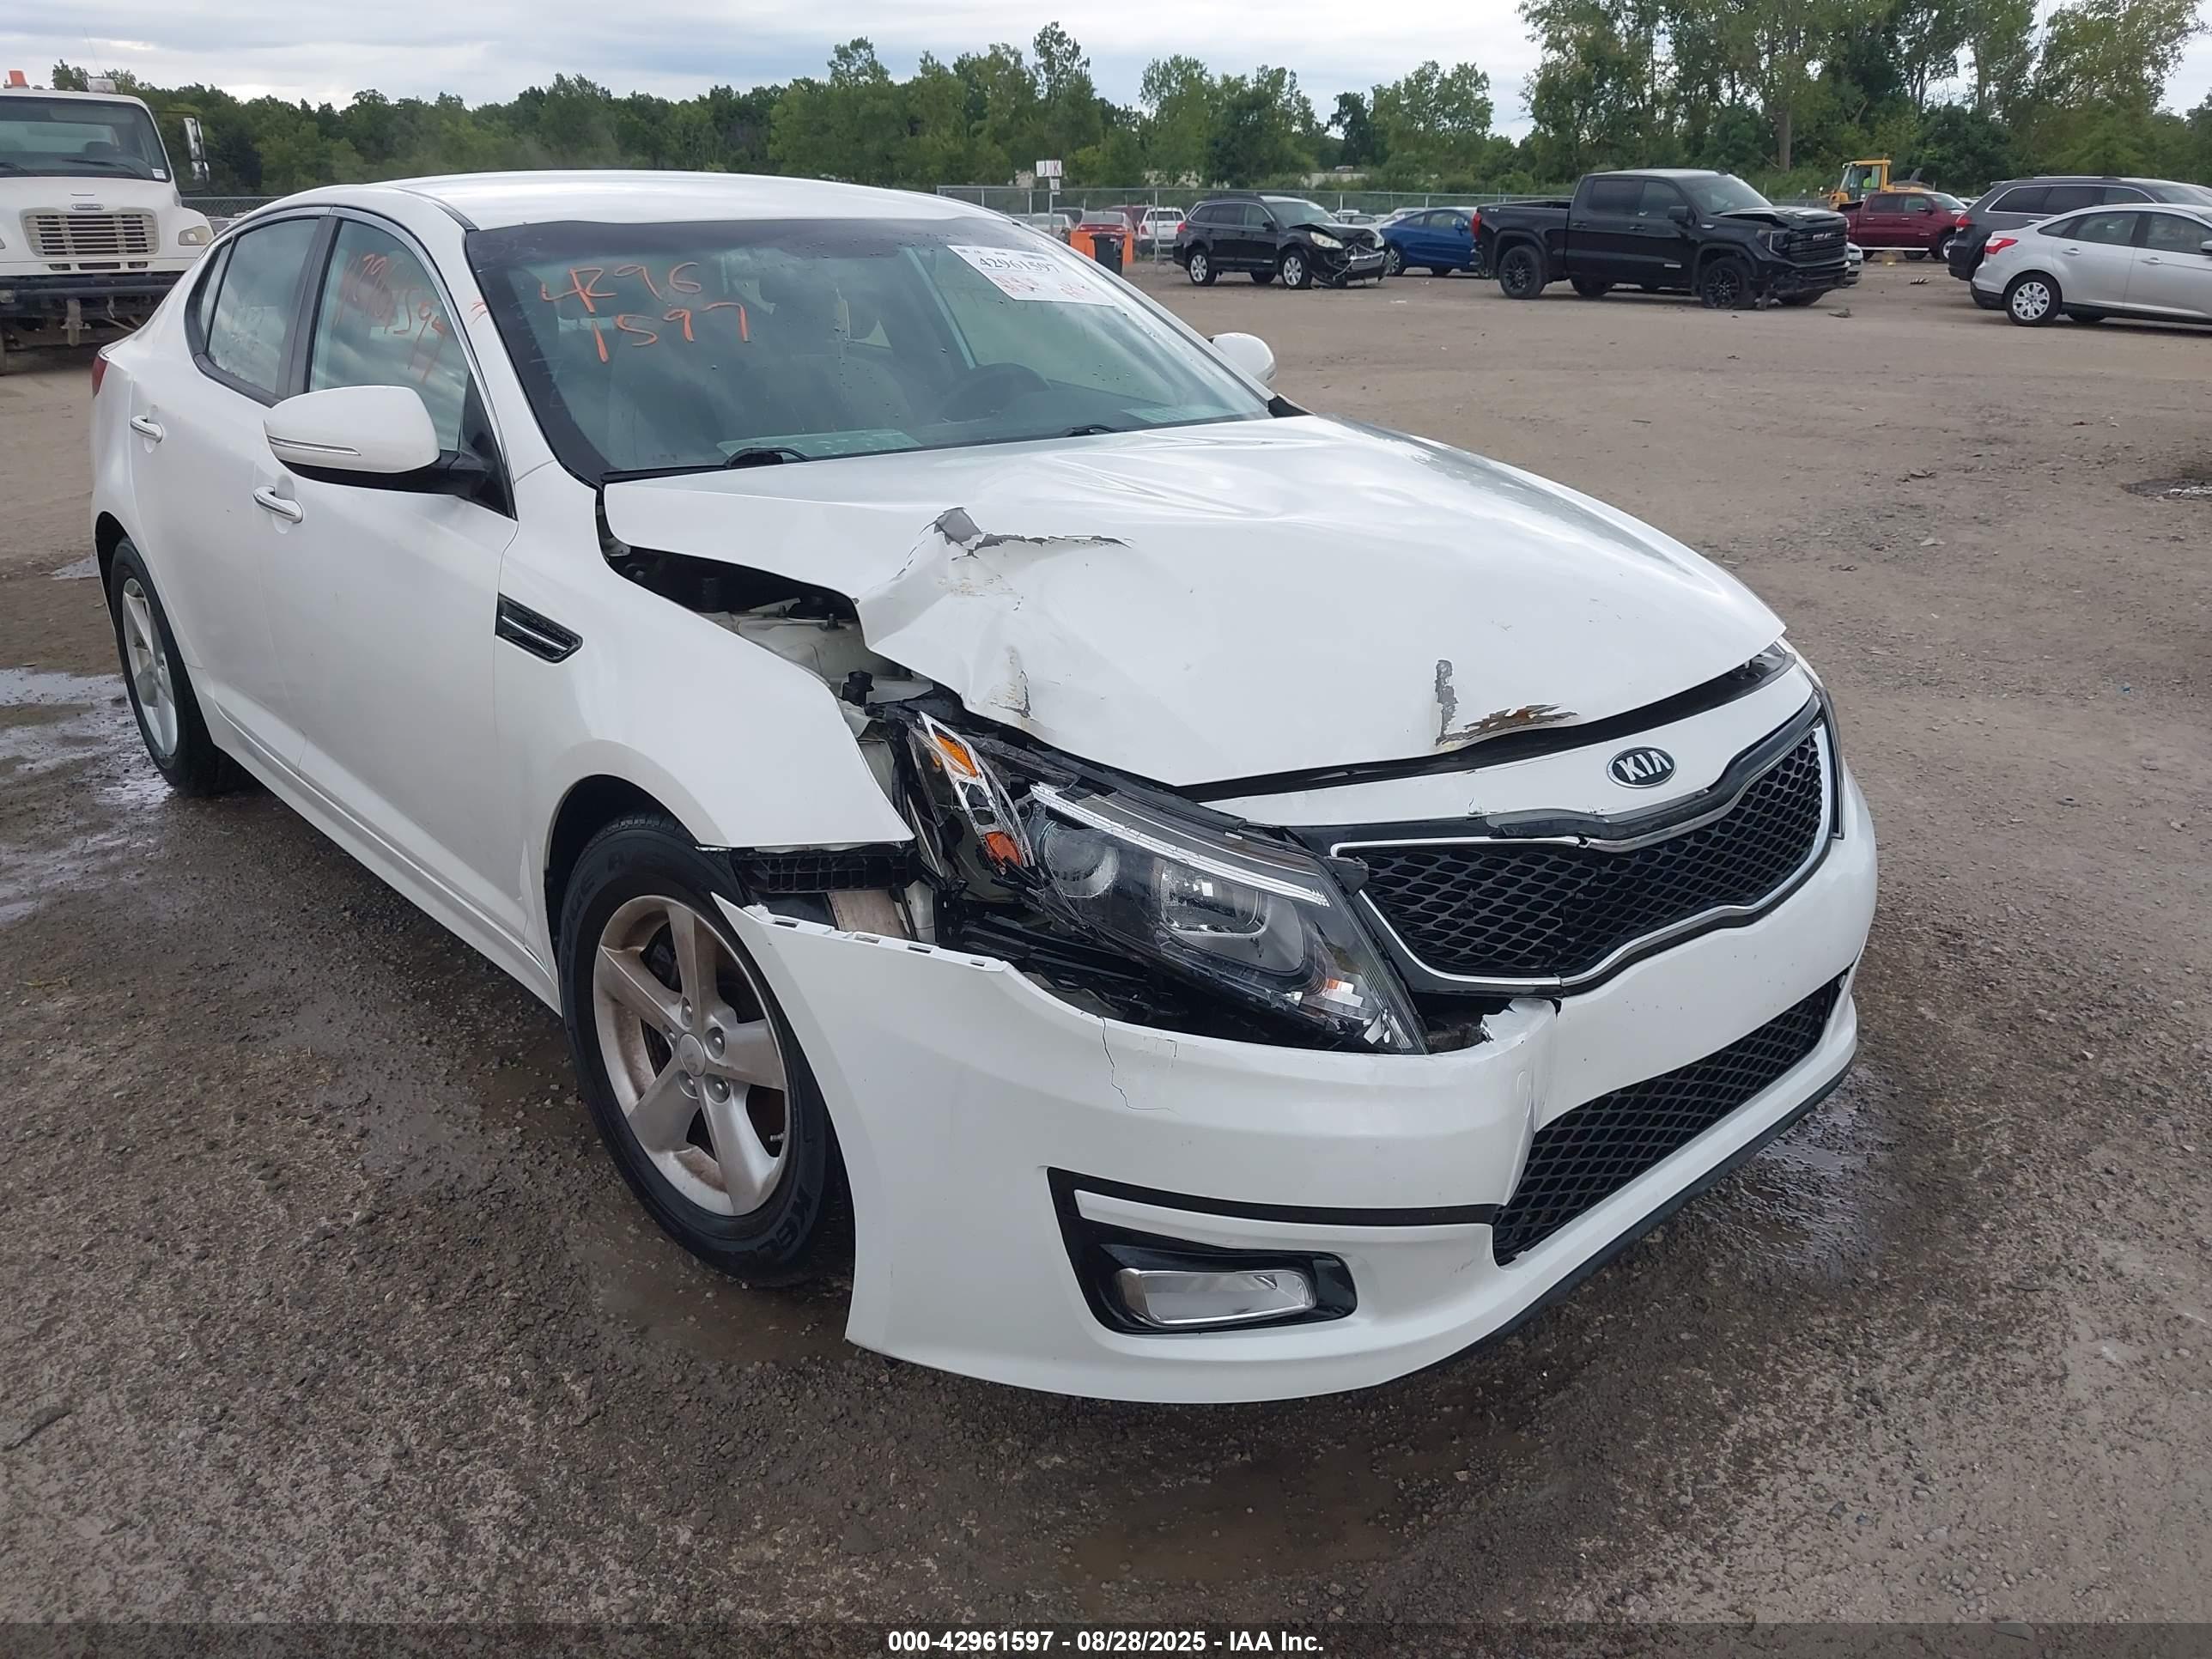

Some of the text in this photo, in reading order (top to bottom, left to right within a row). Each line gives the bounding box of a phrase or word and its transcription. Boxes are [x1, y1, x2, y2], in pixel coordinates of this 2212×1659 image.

[978, 257, 1060, 274] 42961597
[591, 301, 751, 363] 1597
[1615, 750, 1673, 781] KIA
